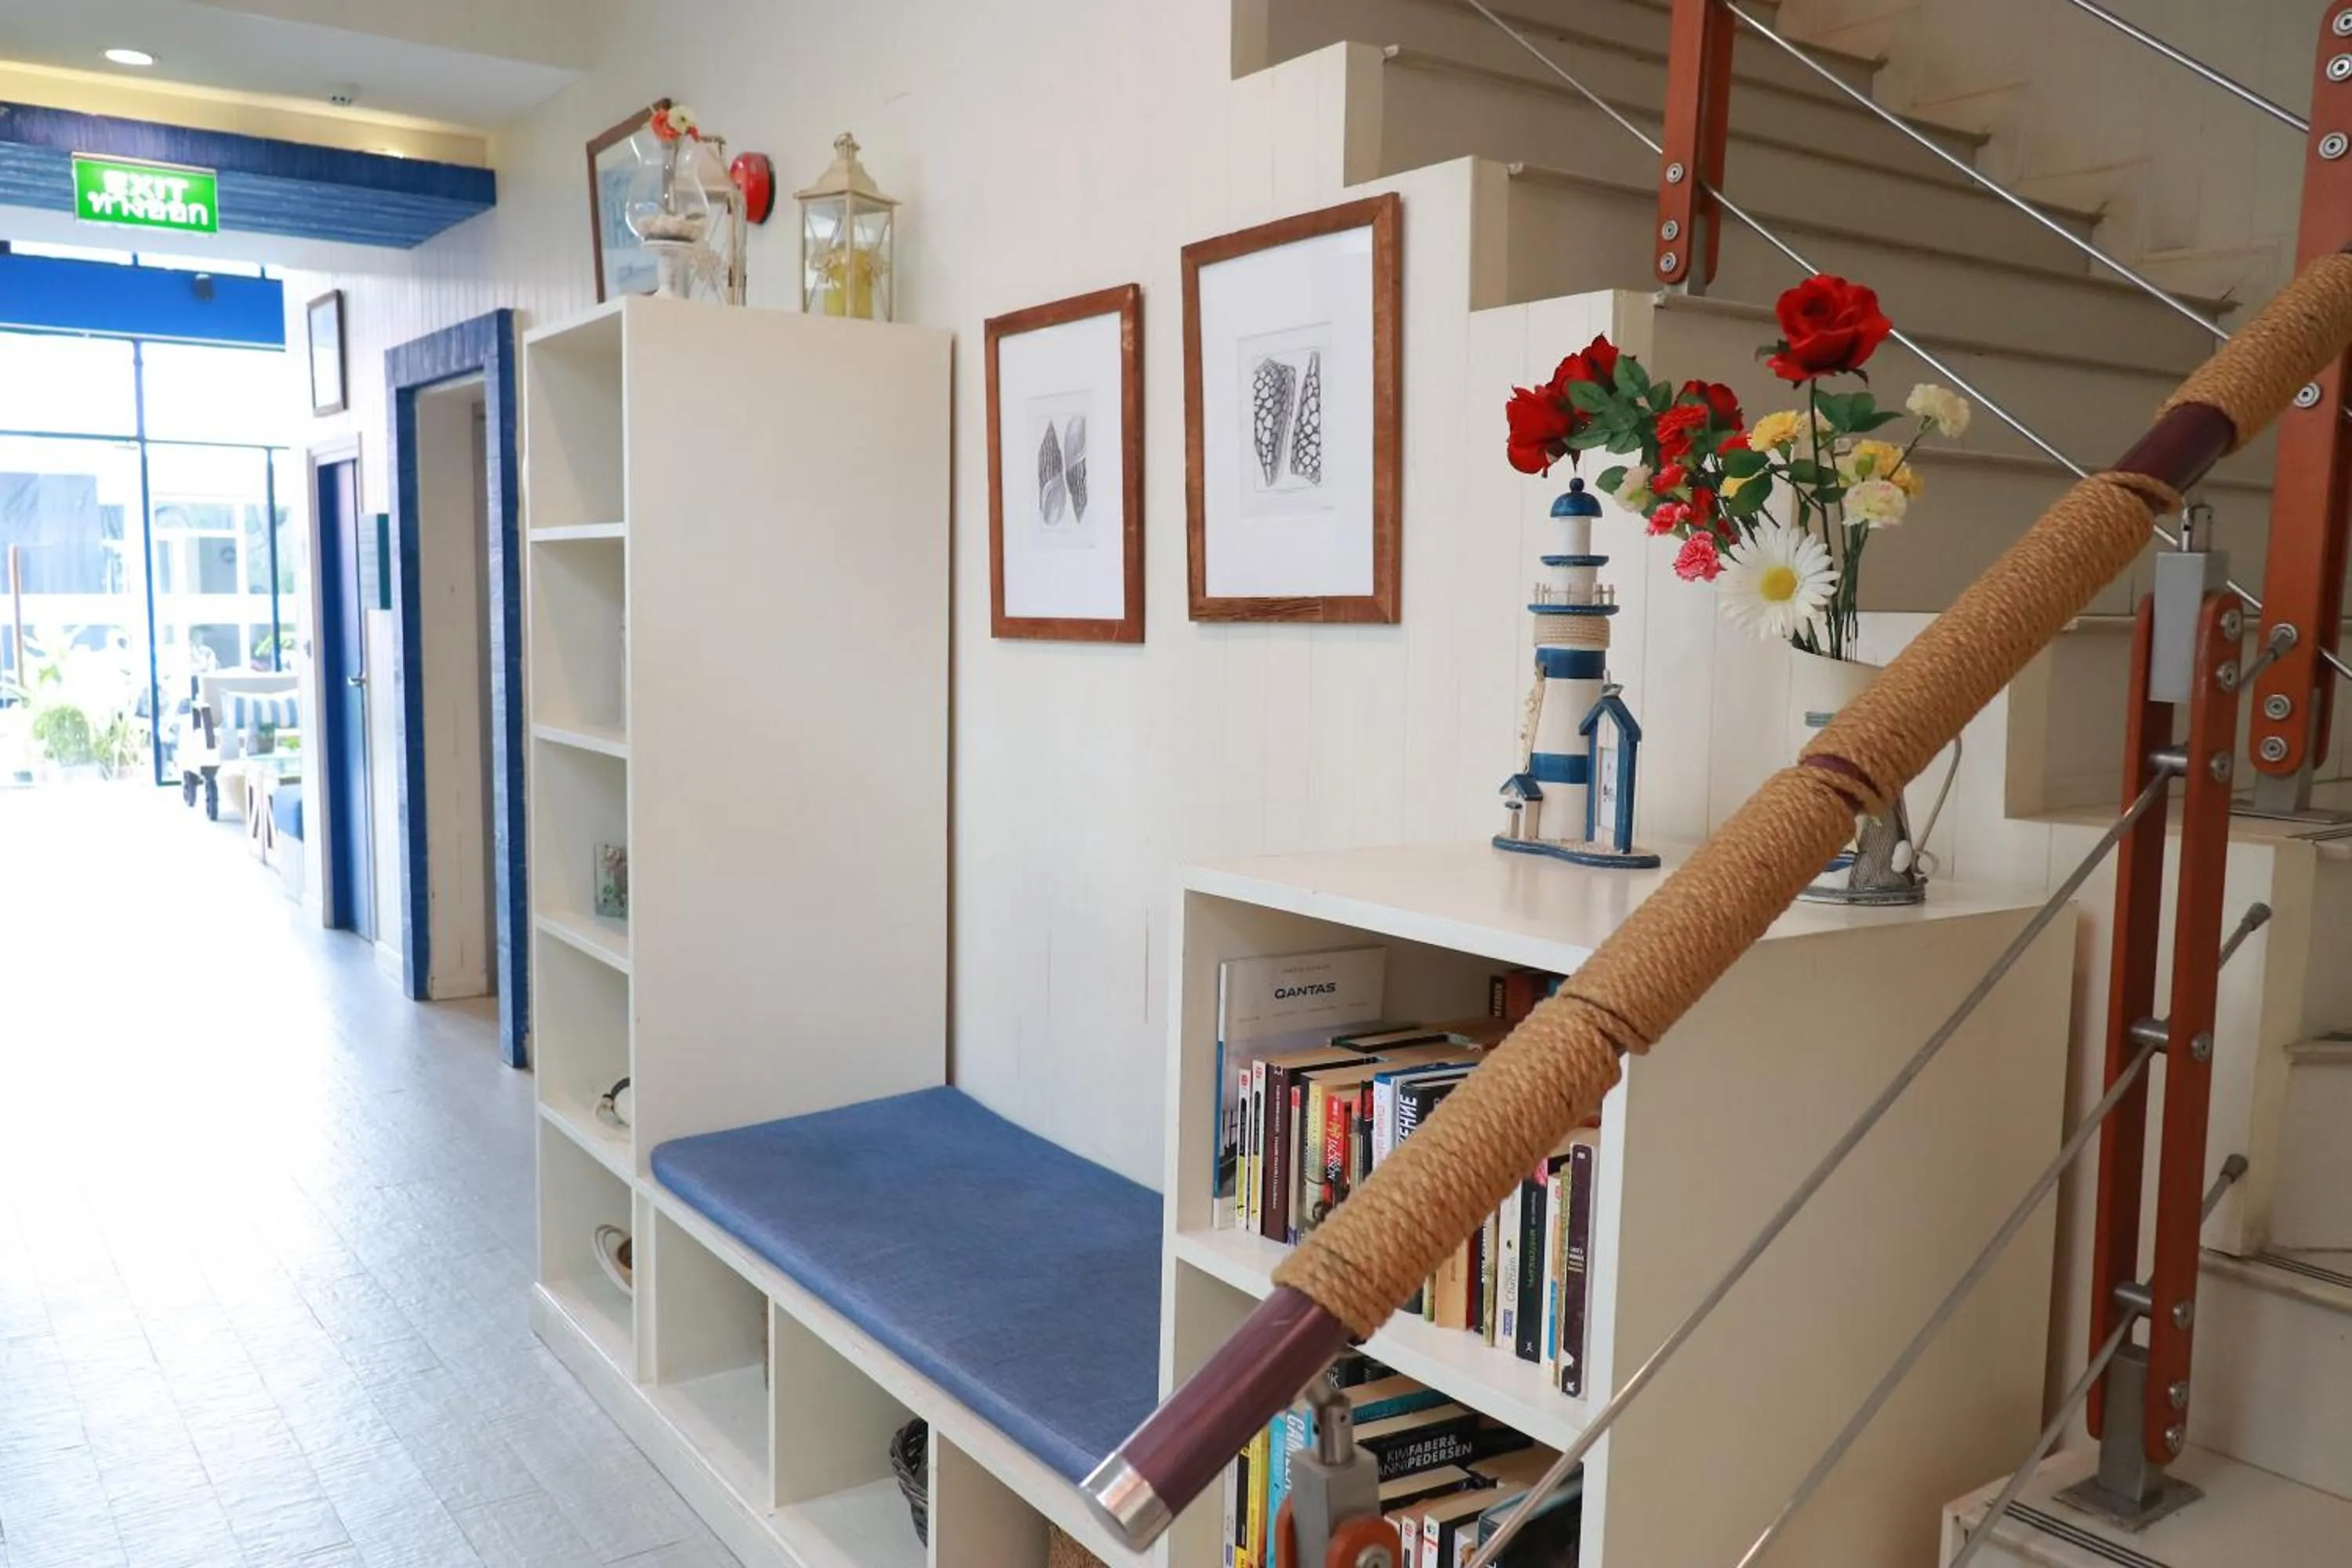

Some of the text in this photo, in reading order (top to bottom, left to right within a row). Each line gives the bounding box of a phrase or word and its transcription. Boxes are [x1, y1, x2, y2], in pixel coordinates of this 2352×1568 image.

[103, 170, 188, 201] EXIT
[87, 191, 209, 226] ทางออก
[1274, 982, 1336, 1000] QANTAS
[1399, 1094, 1417, 1142] ЕНИЕ
[1407, 1443, 1472, 1468] PEDERSEN
